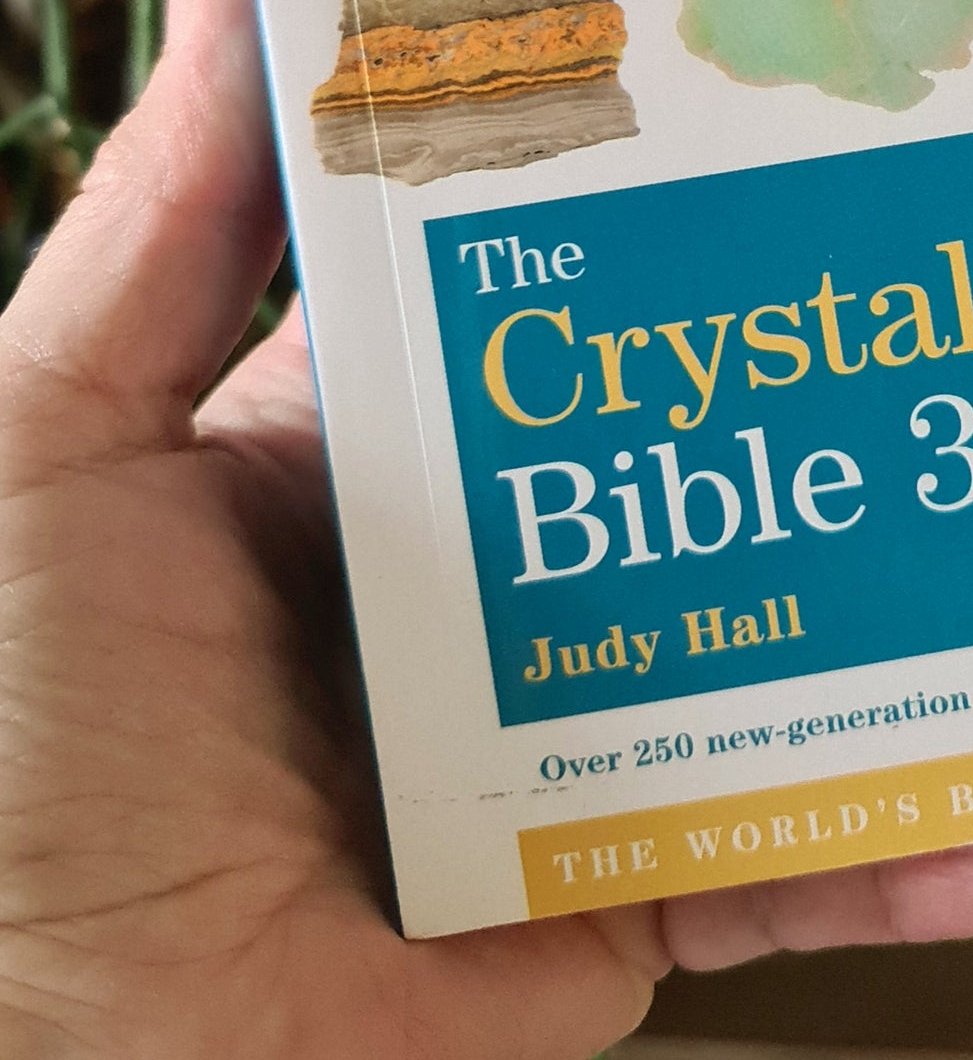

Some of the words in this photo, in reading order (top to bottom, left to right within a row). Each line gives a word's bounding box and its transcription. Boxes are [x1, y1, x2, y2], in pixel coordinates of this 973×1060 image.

[459, 235, 586, 295] The
[496, 426, 867, 587] Bible
[524, 625, 660, 683] Judy
[681, 594, 806, 657] Hall
[540, 748, 622, 781] Over
[633, 732, 694, 764] 250
[707, 691, 972, 754] new-generation
[553, 837, 659, 884] THE
[686, 792, 921, 862] WORLD'S
